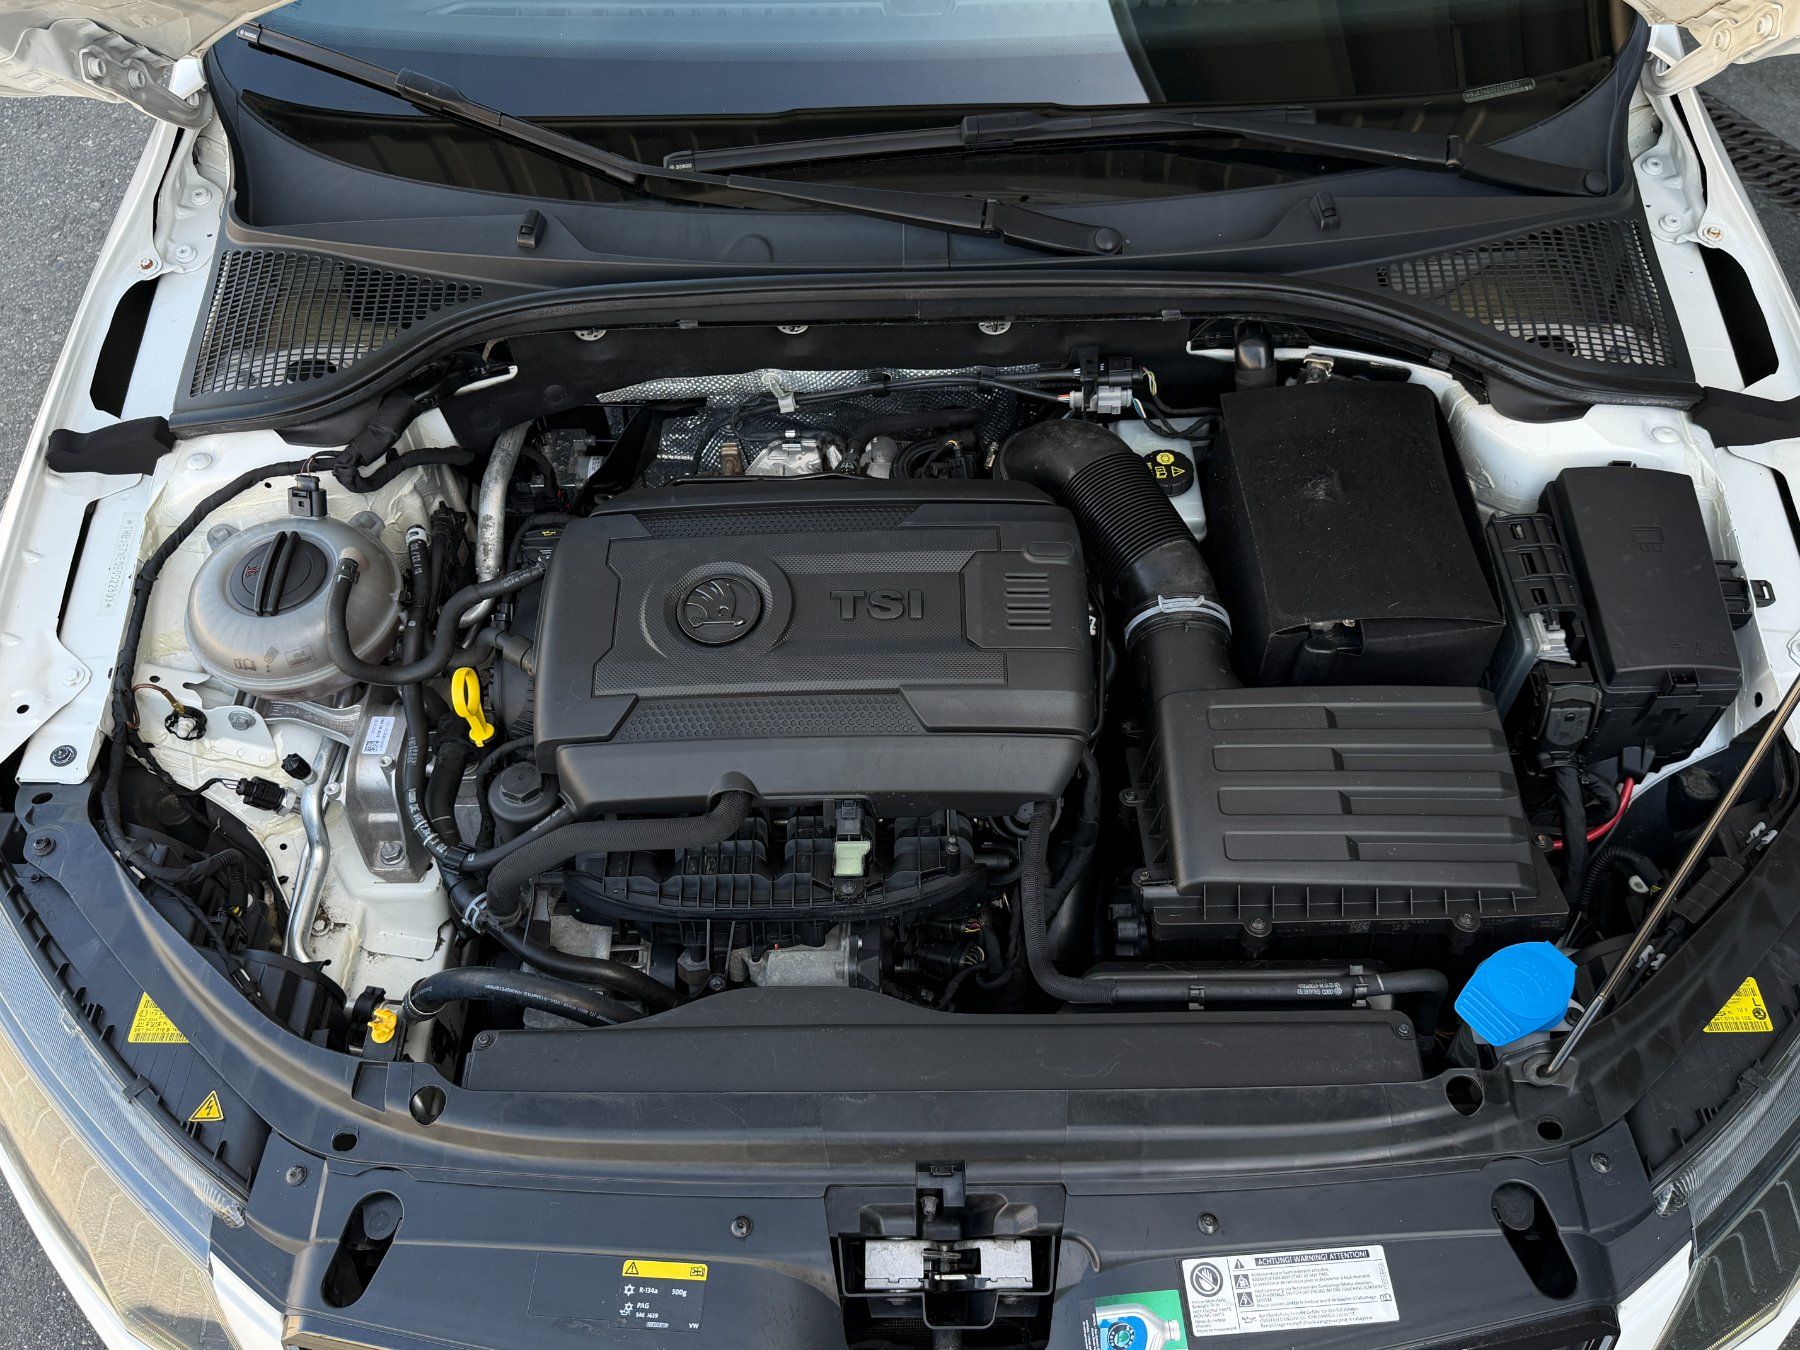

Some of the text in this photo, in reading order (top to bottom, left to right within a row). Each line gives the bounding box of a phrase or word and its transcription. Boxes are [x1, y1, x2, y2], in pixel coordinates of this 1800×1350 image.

[830, 589, 924, 620] TSI
[1752, 997, 1761, 1006] L
[1258, 1251, 1367, 1265] ACHTUNG! WARNING! ATTENTION!
[639, 1286, 687, 1298] R-134a 500g
